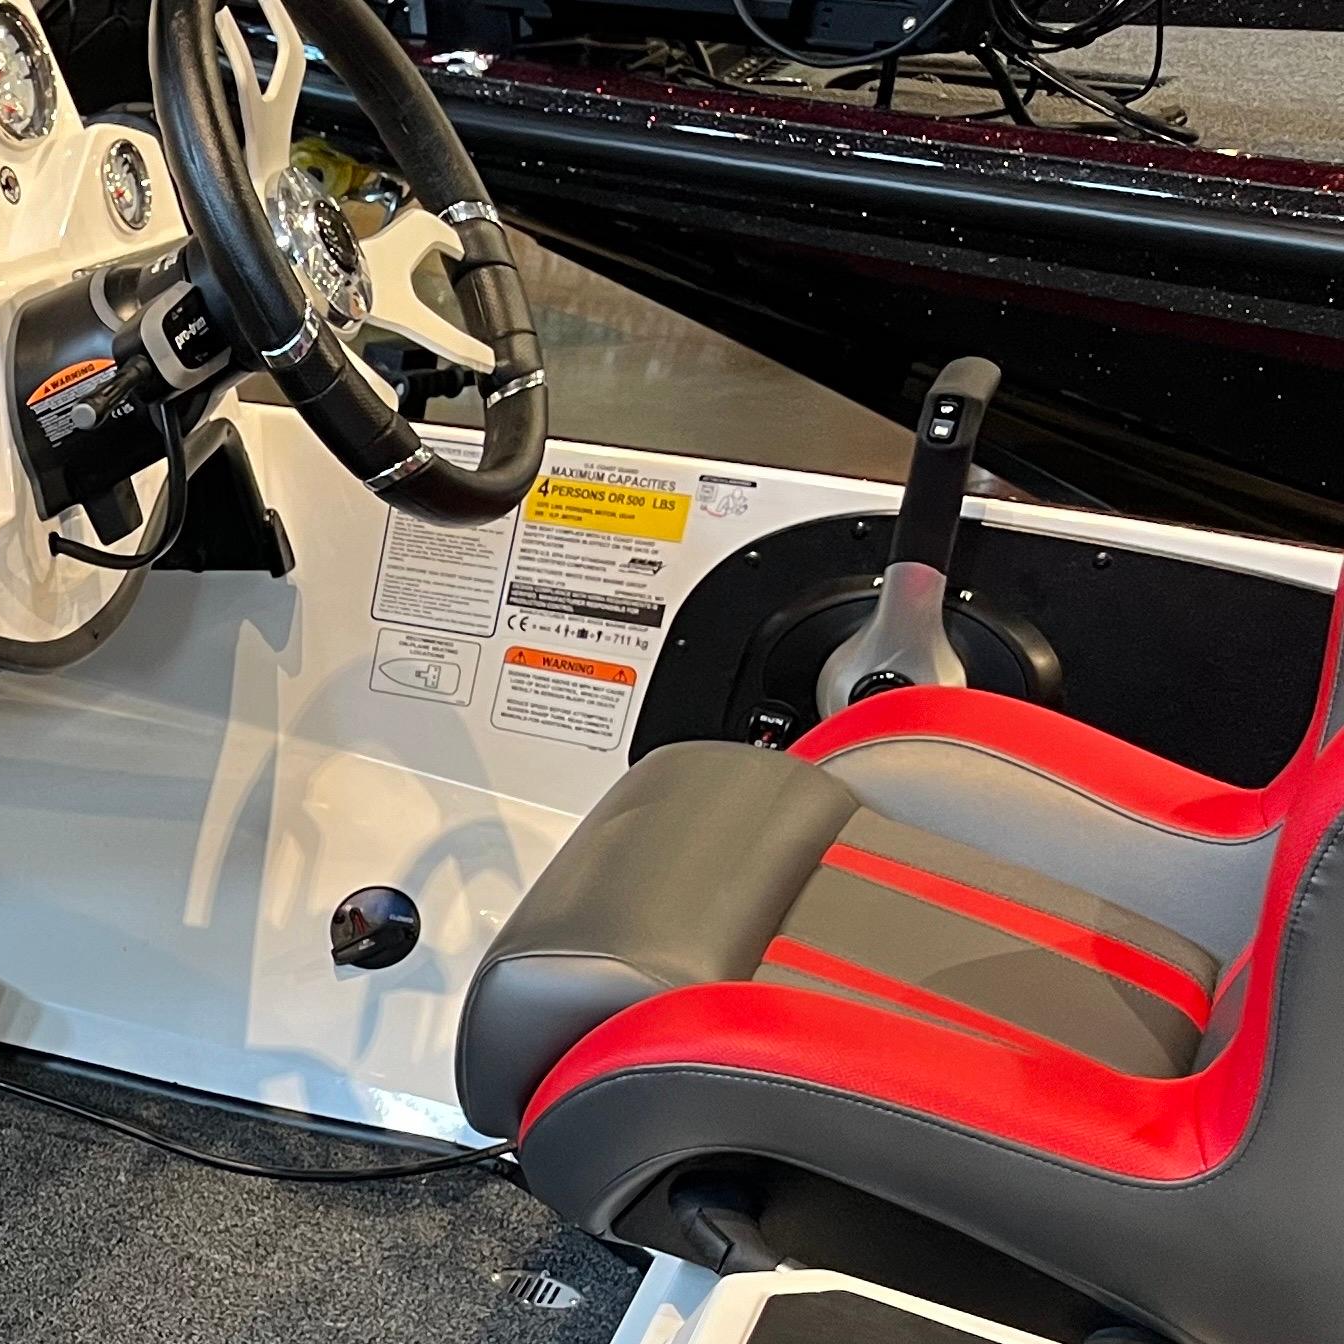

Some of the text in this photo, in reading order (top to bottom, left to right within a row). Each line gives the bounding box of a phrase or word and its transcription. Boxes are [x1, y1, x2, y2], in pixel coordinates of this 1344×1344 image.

[50, 364, 95, 390] WARNING
[551, 466, 676, 491] MAXIMUM CAPACITIES
[538, 478, 676, 511] 4 PERSONS OR 500 LBS
[614, 634, 631, 646] 711
[636, 636, 649, 650] kg
[542, 656, 594, 675] WARNING
